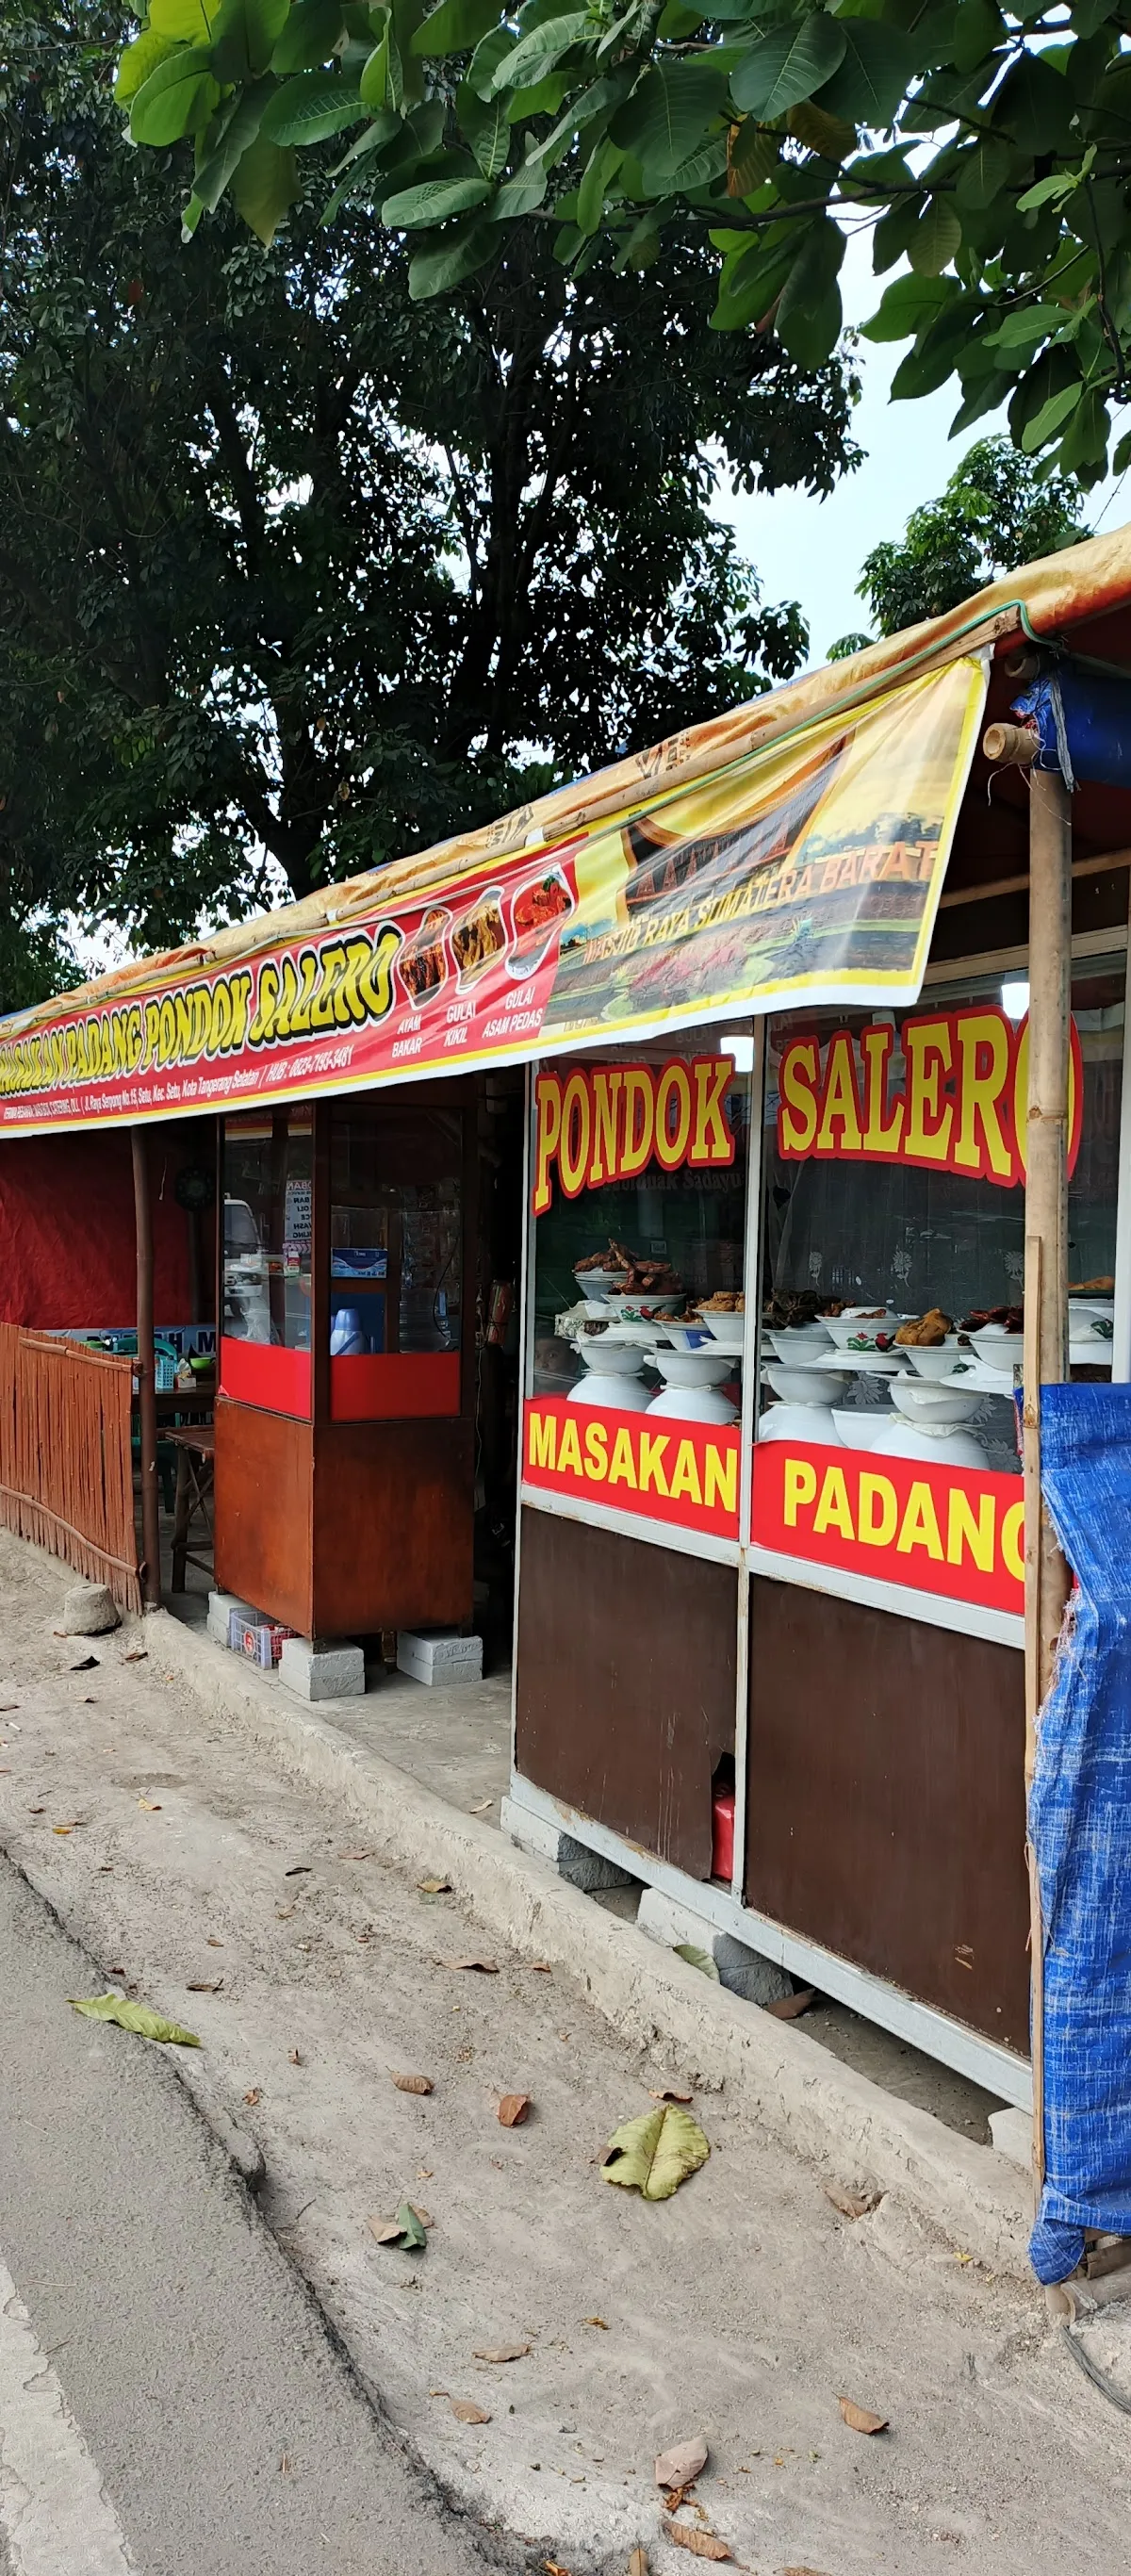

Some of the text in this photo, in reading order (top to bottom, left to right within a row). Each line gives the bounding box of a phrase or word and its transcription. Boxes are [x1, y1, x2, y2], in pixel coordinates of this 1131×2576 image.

[643, 907, 691, 947] RAYA
[693, 862, 814, 930] SUMATERA
[817, 839, 939, 894] BARAT
[66, 1012, 140, 1081] PADANG
[144, 973, 251, 1063] PONDOK
[251, 927, 402, 1041] SALERO
[446, 1002, 475, 1024] GULAI
[505, 987, 535, 1010] GULAI
[397, 1015, 422, 1035] AYAM
[443, 1027, 468, 1048] KIKIL
[483, 1019, 510, 1039] ASAM
[510, 1009, 543, 1032] PEDAS
[391, 1038, 423, 1058] BAKAR
[181, 1079, 198, 1098] Kota
[197, 1075, 233, 1098] Tangerang
[231, 1068, 260, 1089] Selatan
[533, 1059, 734, 1212] PONDOK
[529, 1413, 738, 1513] MASAKAN
